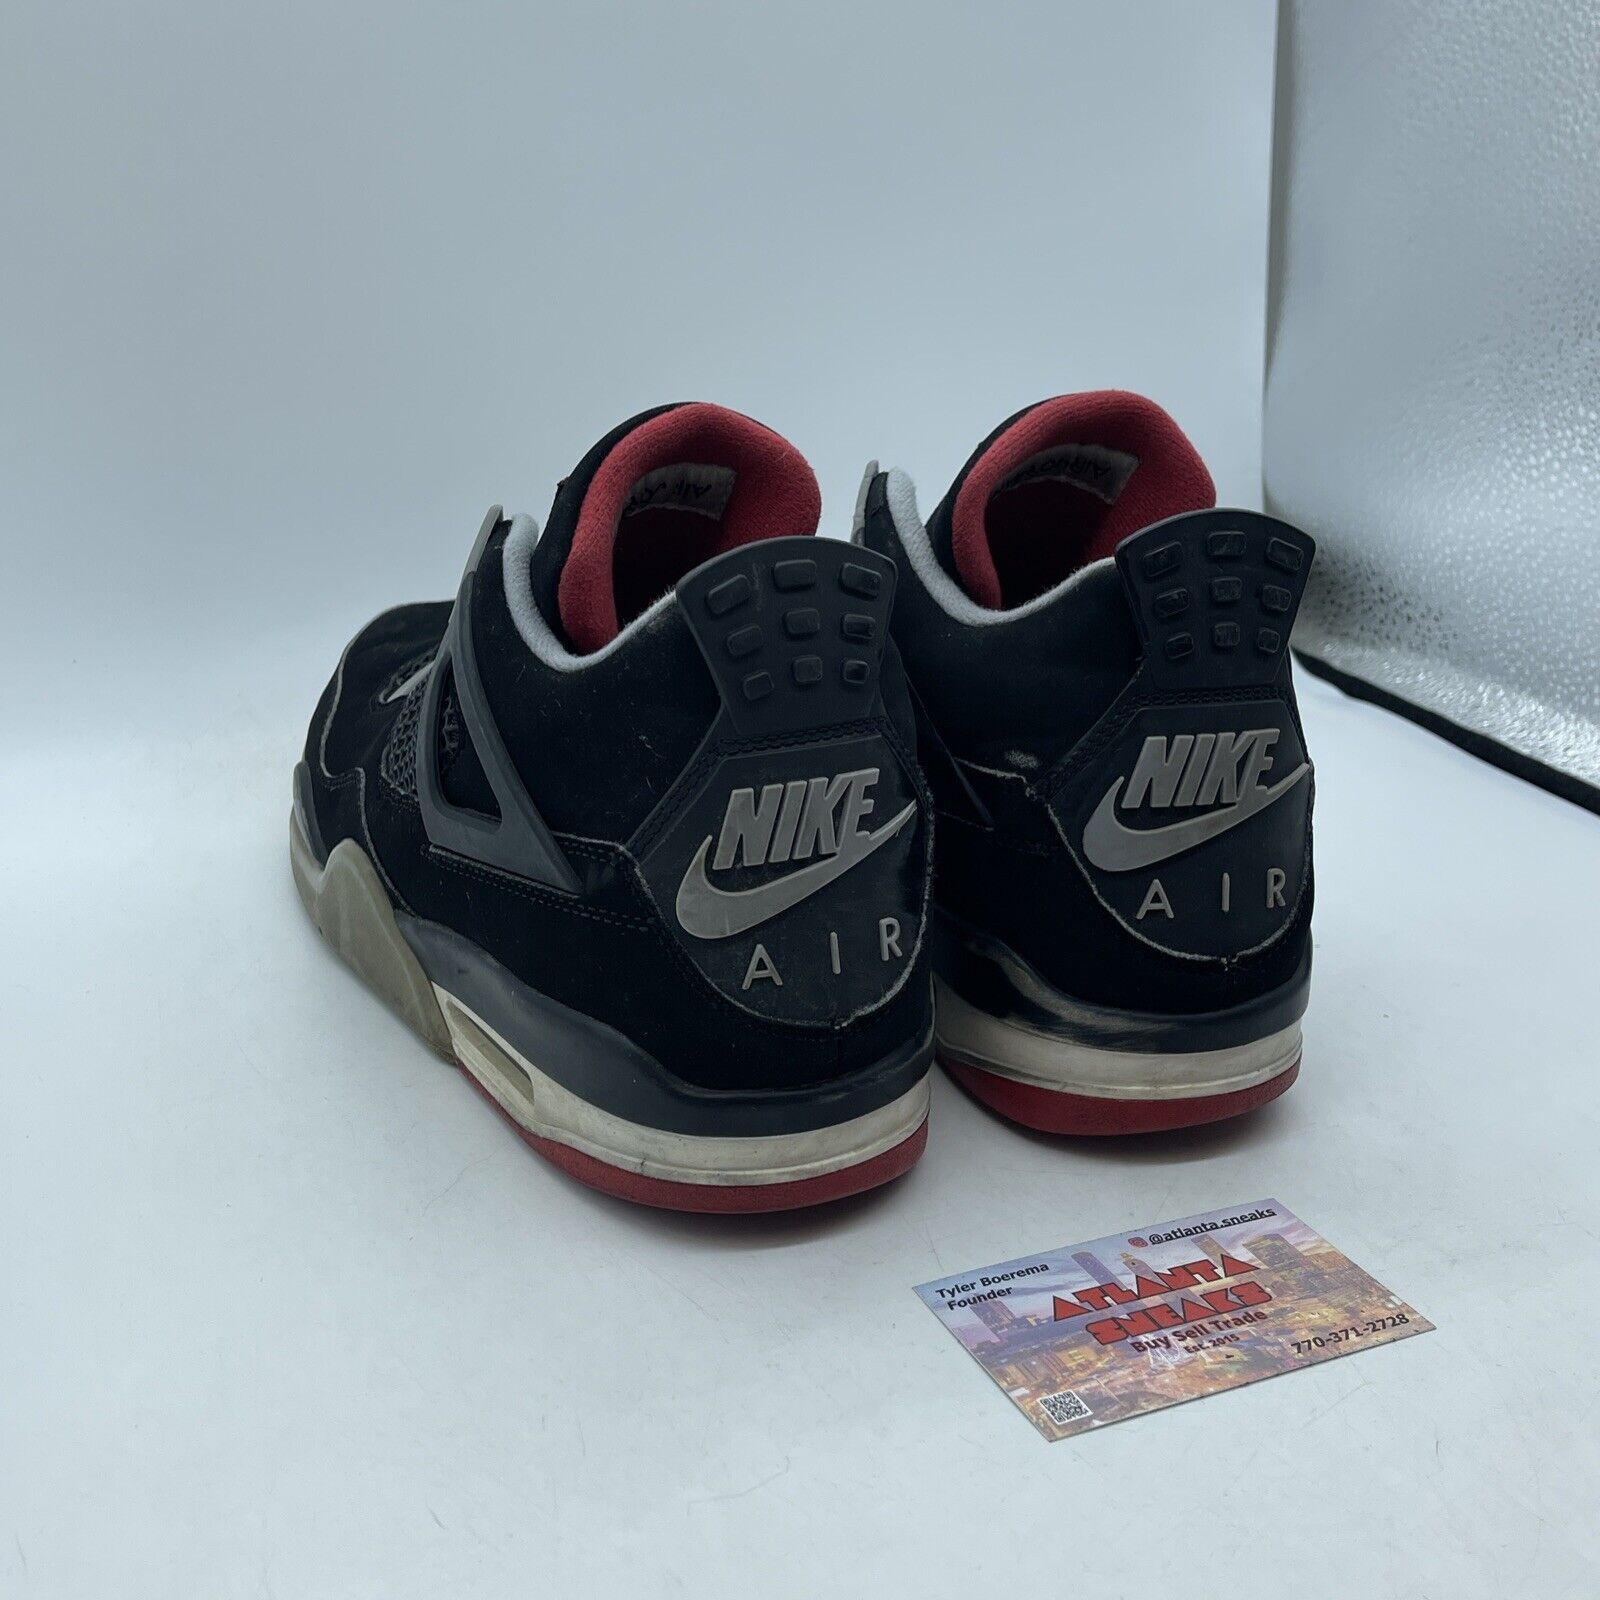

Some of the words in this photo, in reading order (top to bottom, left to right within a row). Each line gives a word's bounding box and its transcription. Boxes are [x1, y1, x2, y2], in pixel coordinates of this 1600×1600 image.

[1121, 728, 1280, 809] NIKE
[712, 767, 880, 870] NIKE
[1135, 868, 1286, 919] AIR
[741, 917, 903, 990] AIR
[1149, 1206, 1277, 1245] @atlanta.sneaks
[935, 1279, 977, 1299] Tyler
[979, 1263, 1049, 1287] Boerema
[947, 1286, 1013, 1310] Founder
[1053, 1253, 1260, 1321] ATLANTA
[1085, 1281, 1272, 1345] SNEAKS
[1130, 1335, 1173, 1352] Buy
[1172, 1324, 1210, 1341] Sell
[1209, 1310, 1268, 1331] Trade
[1291, 1313, 1410, 1354] 770-371-2728
[1209, 1333, 1240, 1347] 2015
